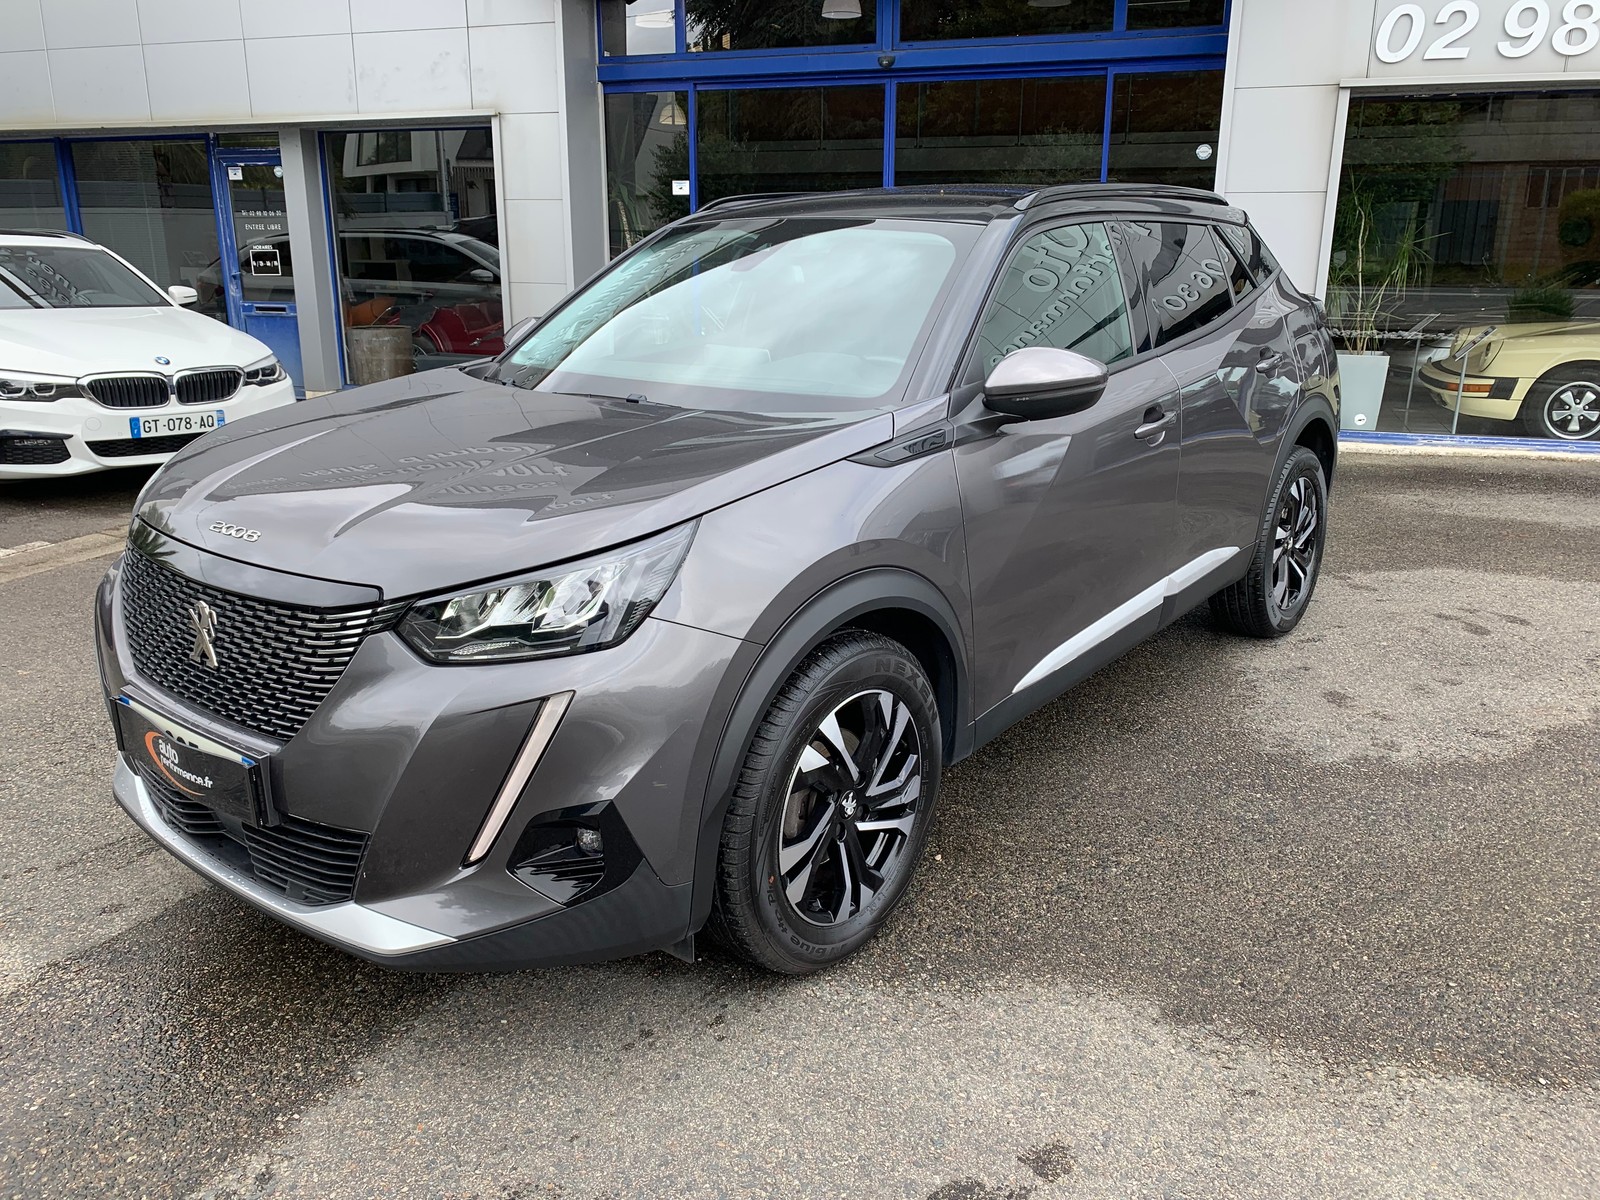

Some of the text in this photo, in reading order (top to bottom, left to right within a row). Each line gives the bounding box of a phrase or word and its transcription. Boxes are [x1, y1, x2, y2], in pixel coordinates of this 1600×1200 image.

[1375, 0, 1600, 64] 02 98
[209, 520, 261, 542] 2008
[158, 738, 179, 764] auto
